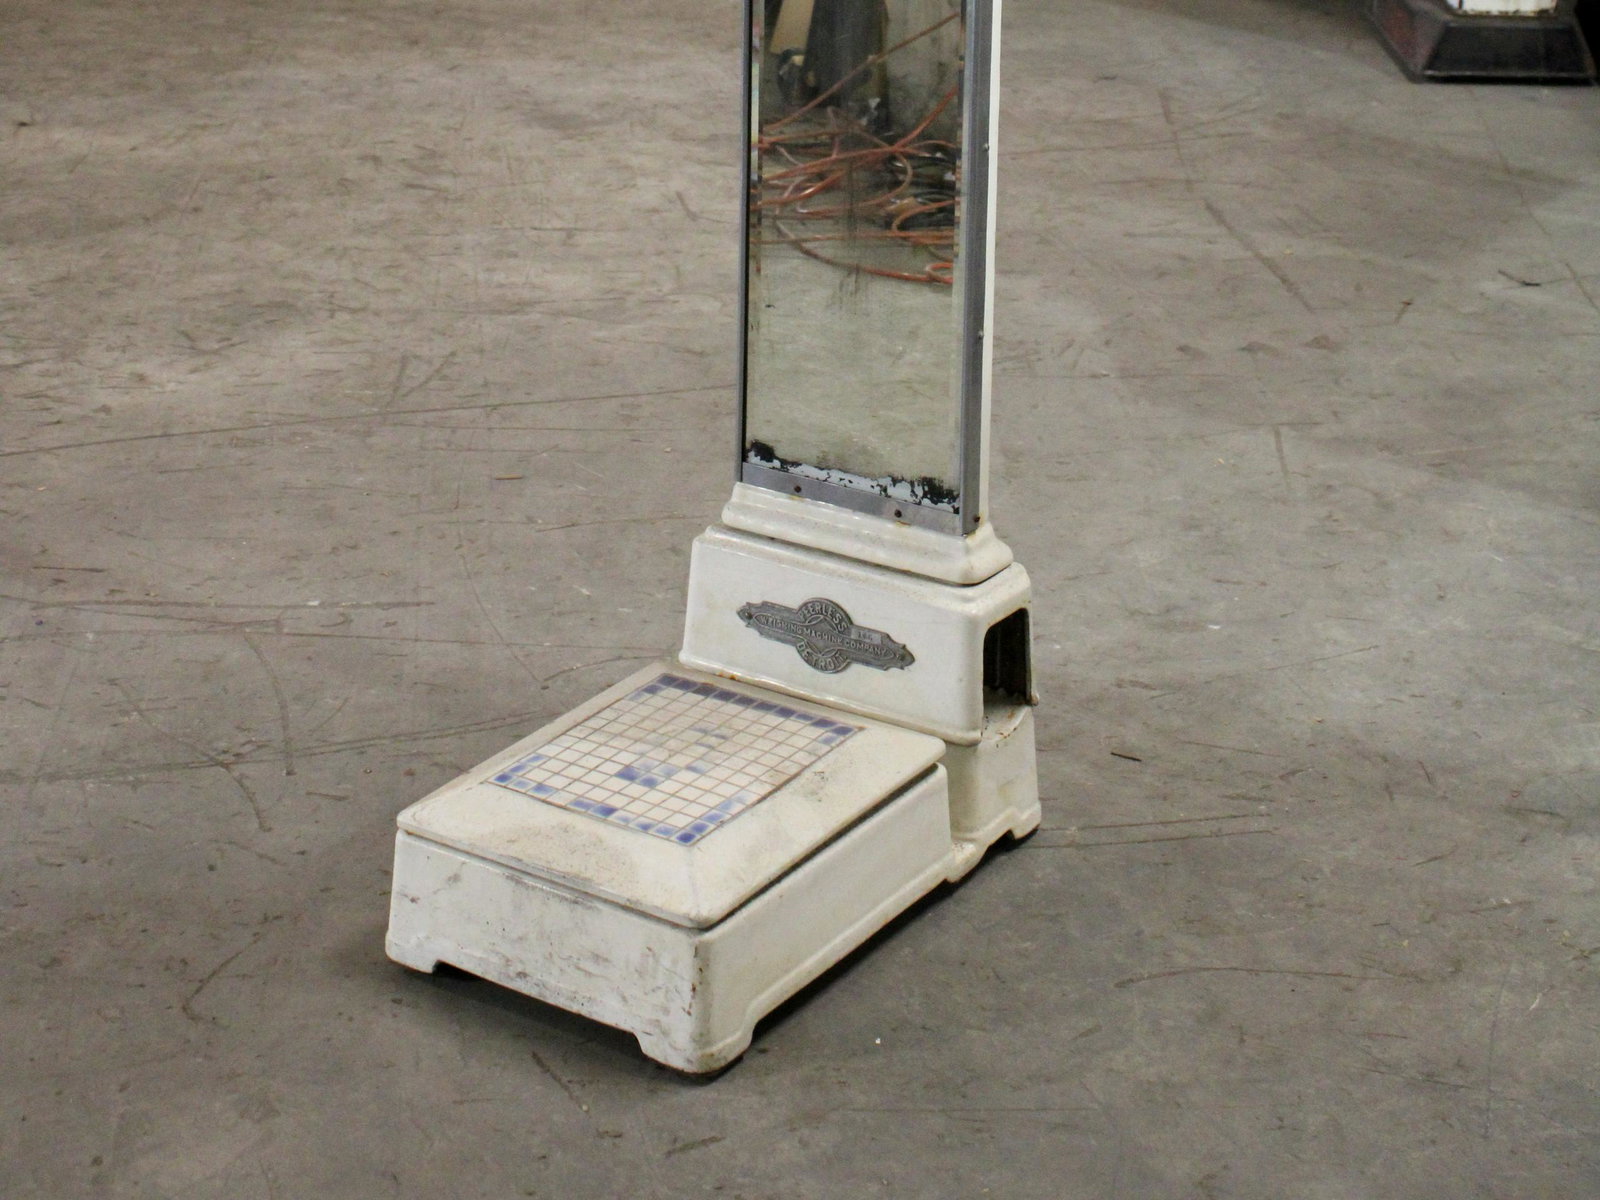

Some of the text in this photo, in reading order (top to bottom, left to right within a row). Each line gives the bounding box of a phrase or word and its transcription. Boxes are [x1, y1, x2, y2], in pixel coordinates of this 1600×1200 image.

[759, 613, 803, 634] WEIGHING
[803, 628, 844, 645] MACHINE
[844, 638, 888, 657] COMPANY
[799, 601, 850, 632] PEERLESS
